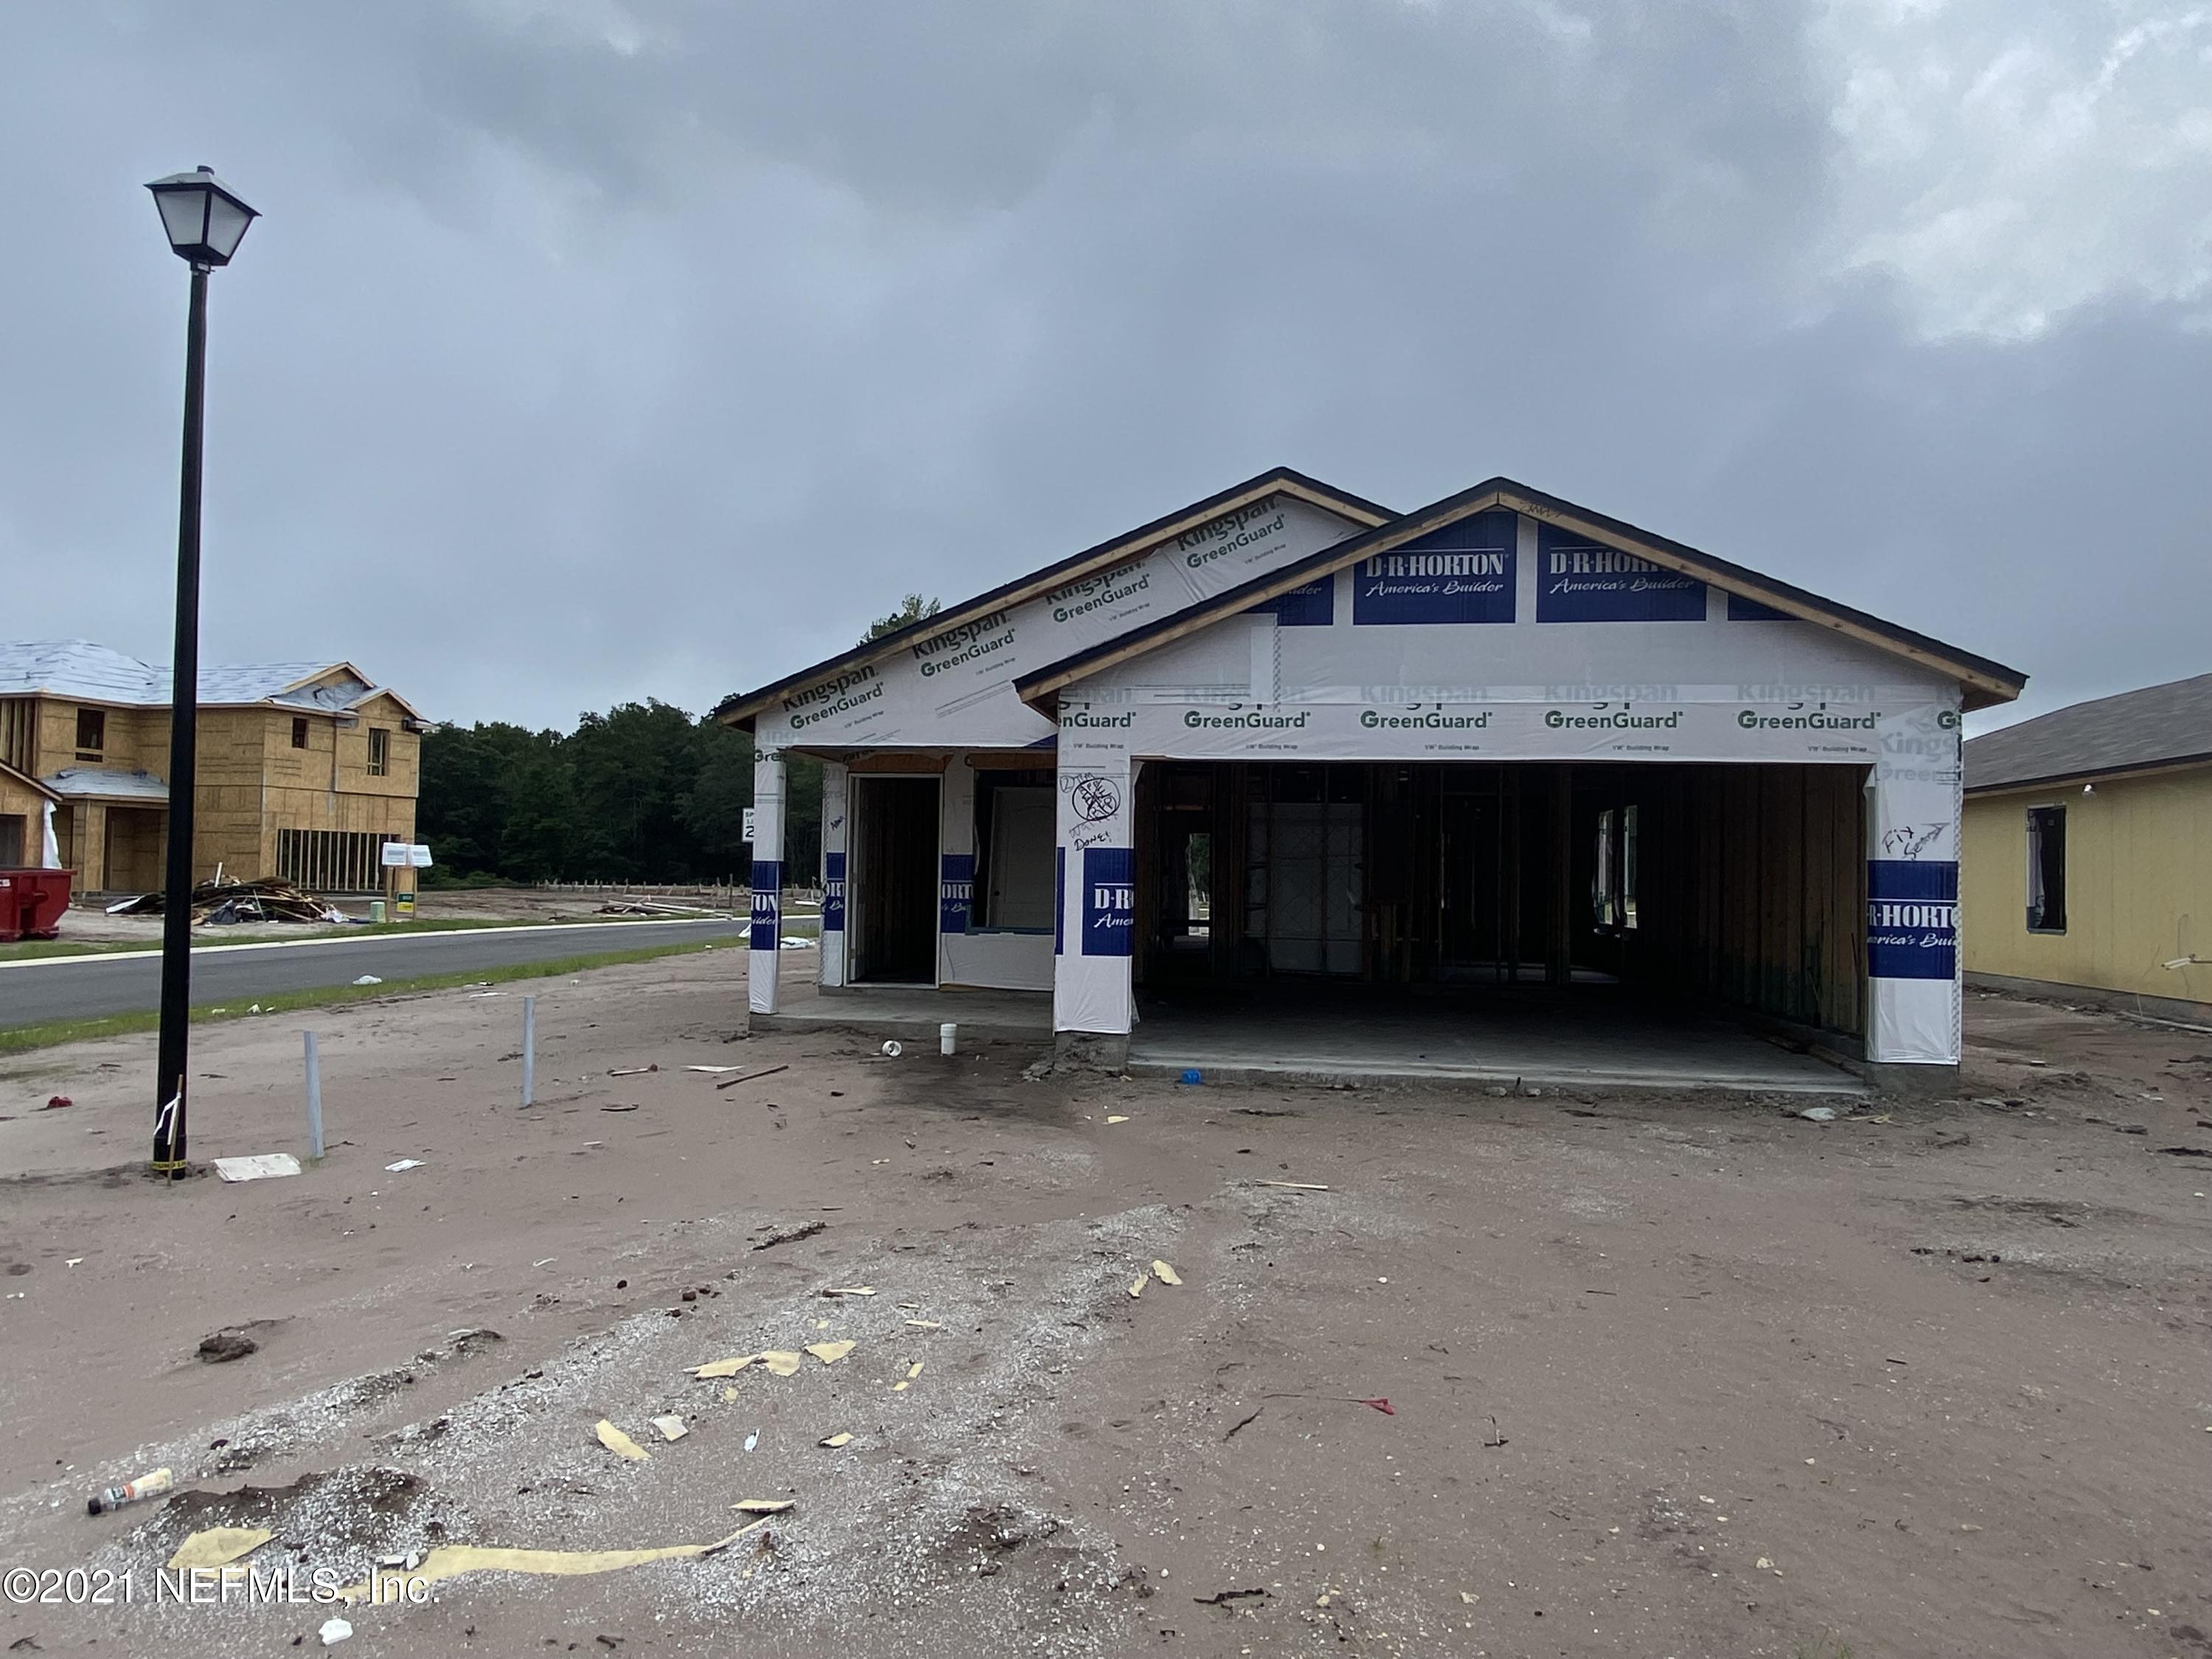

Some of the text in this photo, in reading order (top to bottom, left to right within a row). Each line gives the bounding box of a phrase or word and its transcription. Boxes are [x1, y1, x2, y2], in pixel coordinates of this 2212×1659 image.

[1186, 514, 1284, 568] GreenGuard
[1366, 580, 1503, 597] America's Builder
[1549, 577, 1694, 594] America's Builder
[1052, 573, 1150, 622] GreenGuard
[920, 628, 1016, 677] GreenGuard
[790, 682, 883, 729] GreenGuard
[1184, 710, 1305, 728] GreenGuard
[1360, 710, 1488, 728] GreenGuard
[1545, 710, 1677, 728] GreenGuard
[1737, 710, 1876, 729] GreenGuard
